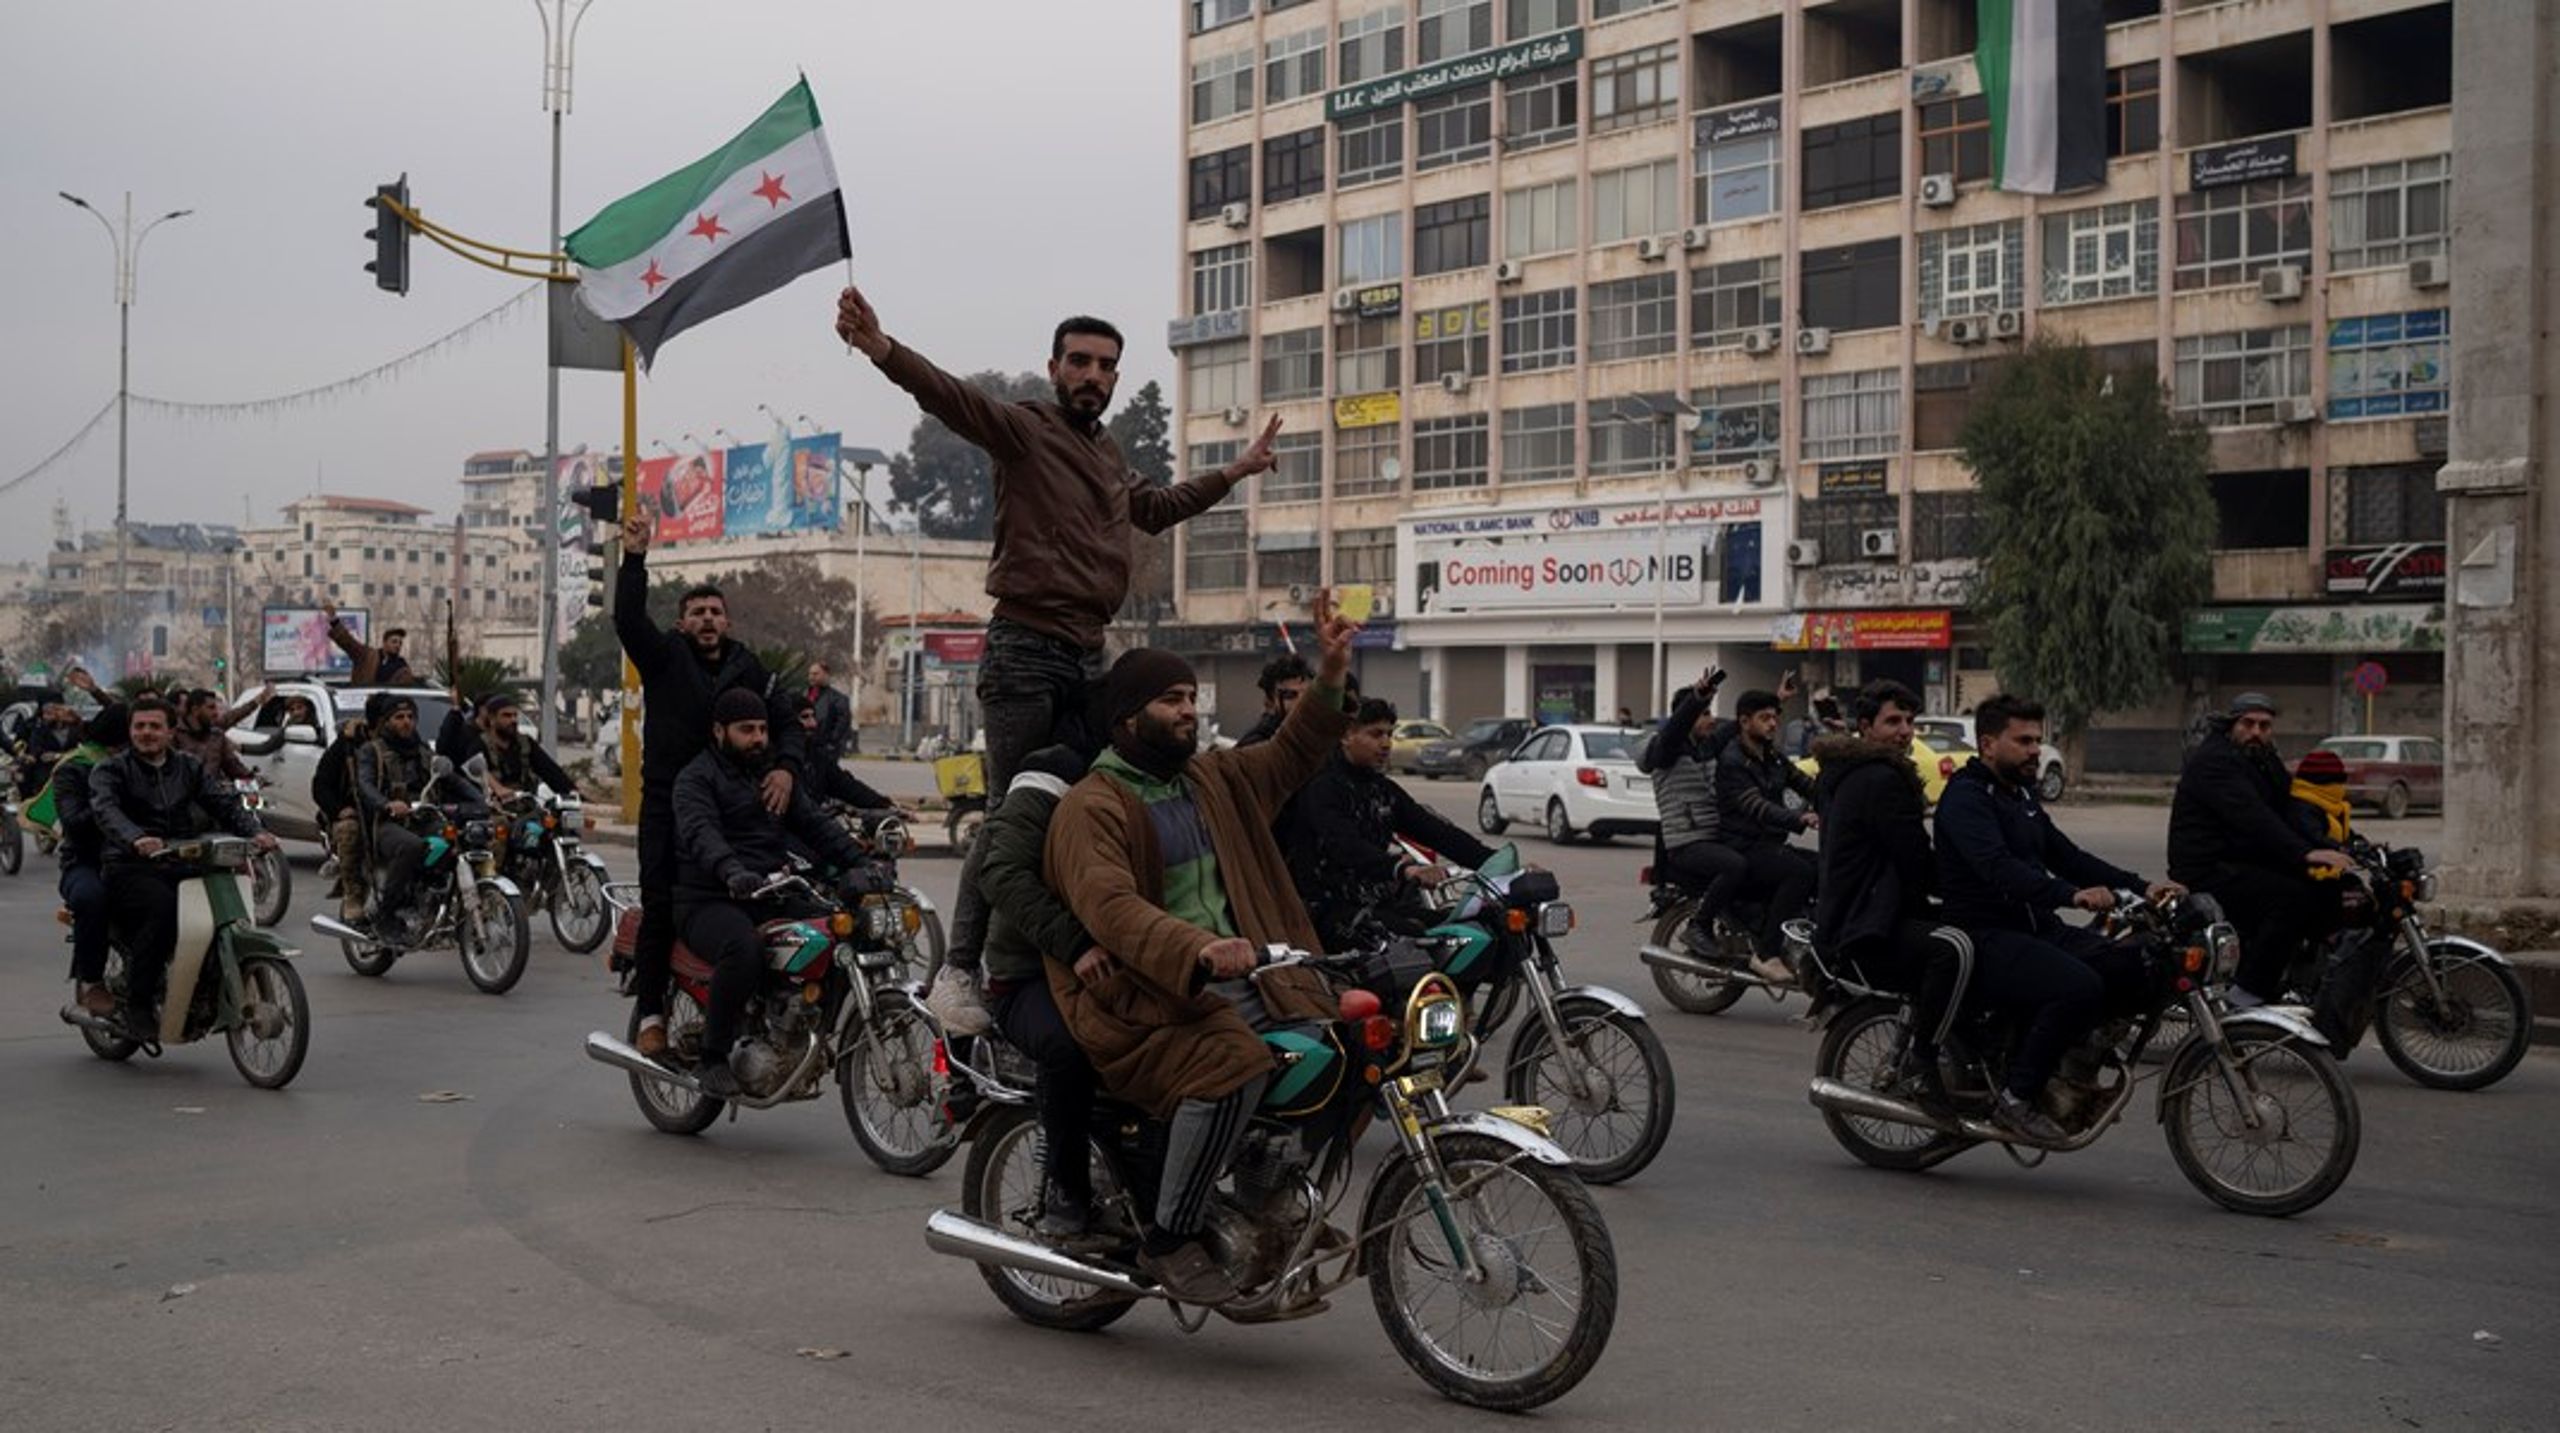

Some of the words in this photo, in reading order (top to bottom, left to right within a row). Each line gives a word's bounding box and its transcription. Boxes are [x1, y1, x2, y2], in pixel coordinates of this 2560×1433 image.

[1575, 508, 1600, 526] NIB
[1725, 499, 1761, 517] البنك
[1414, 520, 1462, 536] NATIONAL
[1464, 517, 1503, 533] ISLAMIC
[1507, 516, 1535, 530] BANK
[1447, 559, 1535, 592] Coming
[1543, 557, 1604, 586] Soon
